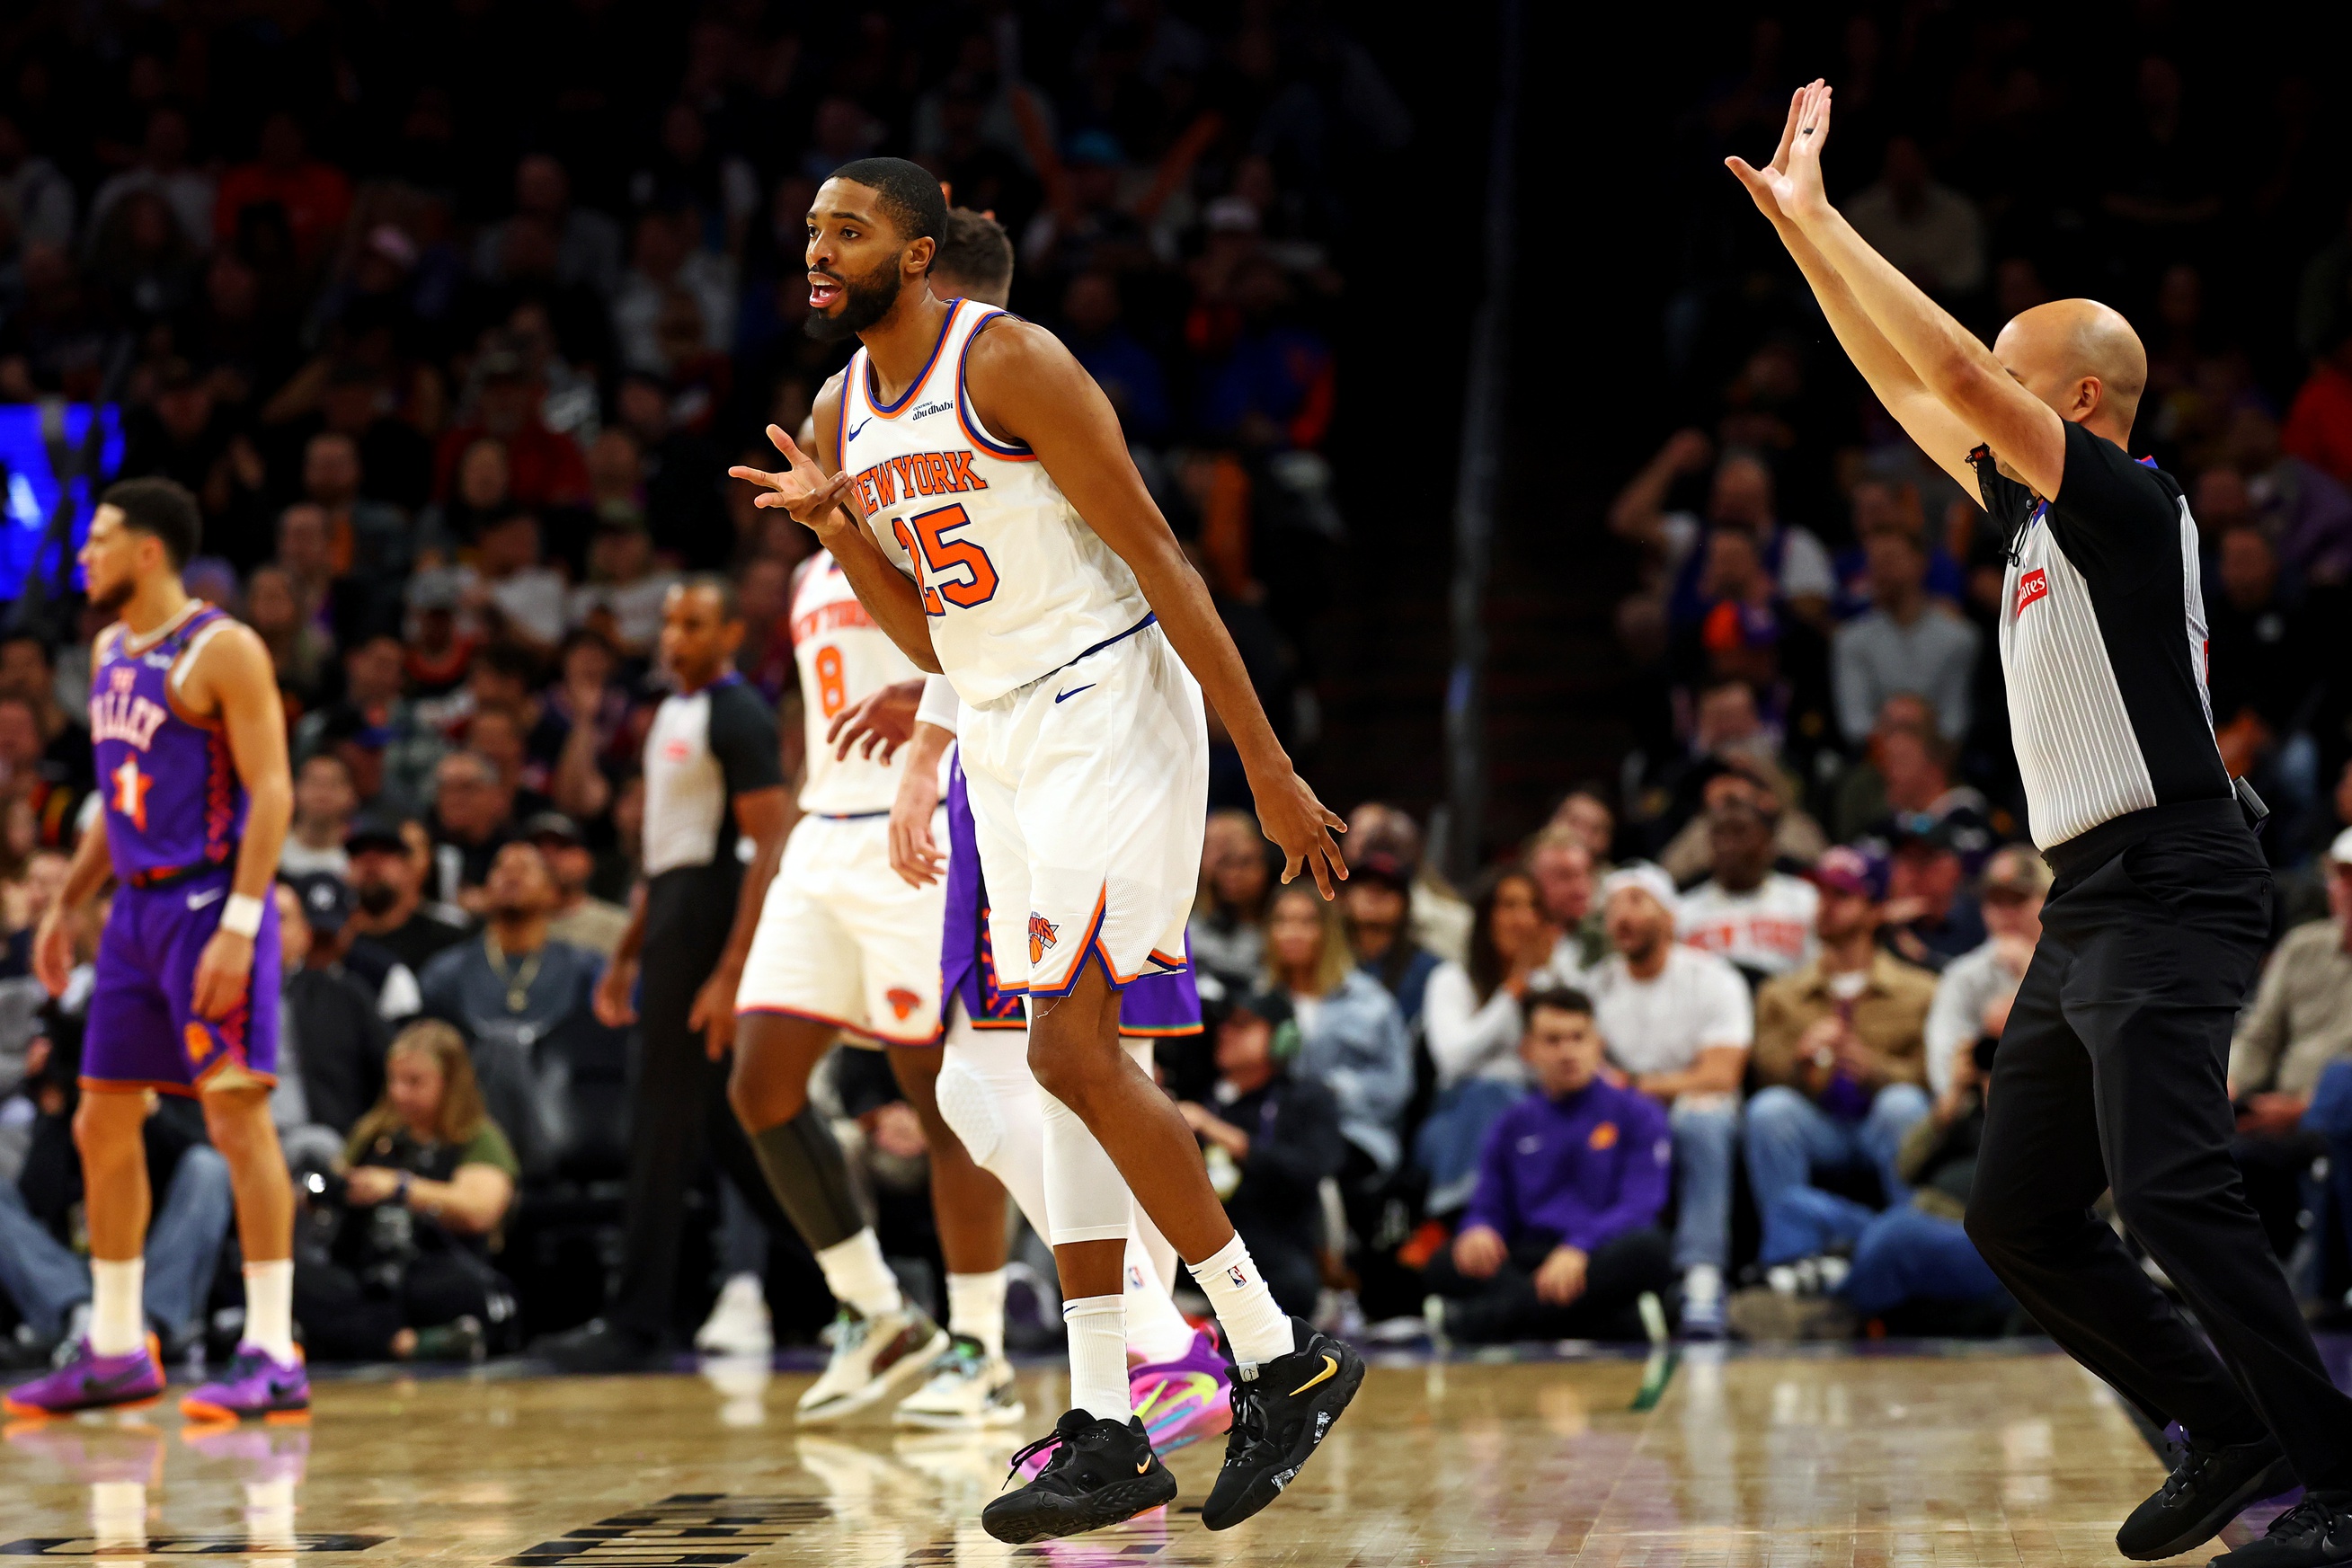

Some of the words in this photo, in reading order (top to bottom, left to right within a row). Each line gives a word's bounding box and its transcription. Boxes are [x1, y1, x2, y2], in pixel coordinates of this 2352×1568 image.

[912, 410, 927, 421] abu
[927, 400, 954, 415] dhabi
[892, 448, 990, 501] YORK
[816, 646, 846, 719] 8
[88, 694, 167, 752] ALLEY
[120, 759, 139, 816] 1
[1029, 917, 1058, 943] ICKS
